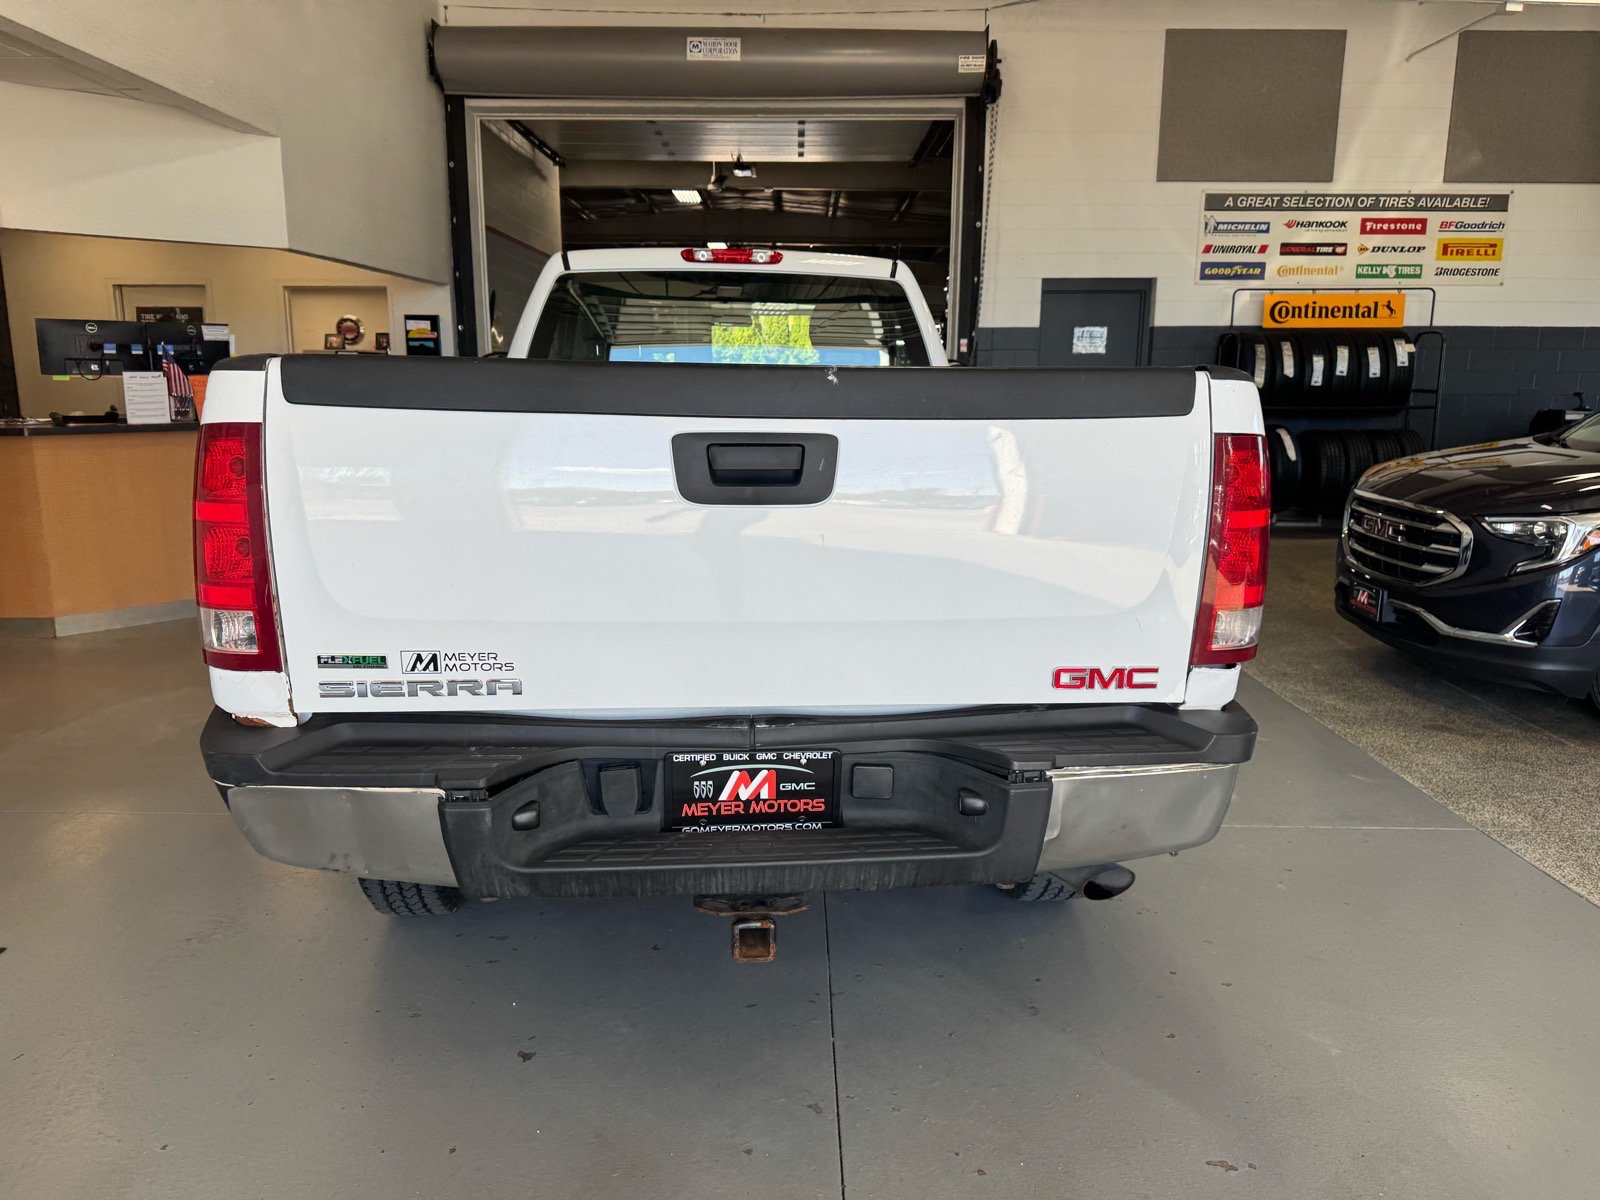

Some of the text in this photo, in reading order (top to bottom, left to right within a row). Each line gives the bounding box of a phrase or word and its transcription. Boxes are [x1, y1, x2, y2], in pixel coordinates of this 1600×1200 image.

[1224, 197, 1490, 208] A GREAT SELECTION OF TIRES AVAILABLE!
[1217, 223, 1268, 231] MICHELIN
[1366, 221, 1422, 232] Firestone
[1439, 220, 1505, 230] BFGoodrich
[1212, 245, 1258, 254] UNIROYAL
[1441, 243, 1498, 256] PIRELLI
[1204, 266, 1262, 276] GOODYEAR
[1277, 265, 1339, 277] Continental
[1357, 266, 1421, 275] KELLY TIRES
[1434, 267, 1501, 277] BRIDGESTONE
[1269, 300, 1379, 324] Continental
[1362, 515, 1405, 542] GMC
[320, 655, 385, 664] FLEXFUEL
[443, 652, 498, 661] MEYER
[443, 663, 515, 672] MOTORS
[1052, 667, 1159, 689] GMC
[319, 678, 523, 698] SIERRA
[673, 751, 833, 762] CERTIFIED BUICK GMC CHEVROLET
[779, 782, 816, 791] GMC
[681, 798, 826, 817] MEYER MOTORS
[682, 823, 822, 833] GOMEYERMOTORSCOM
